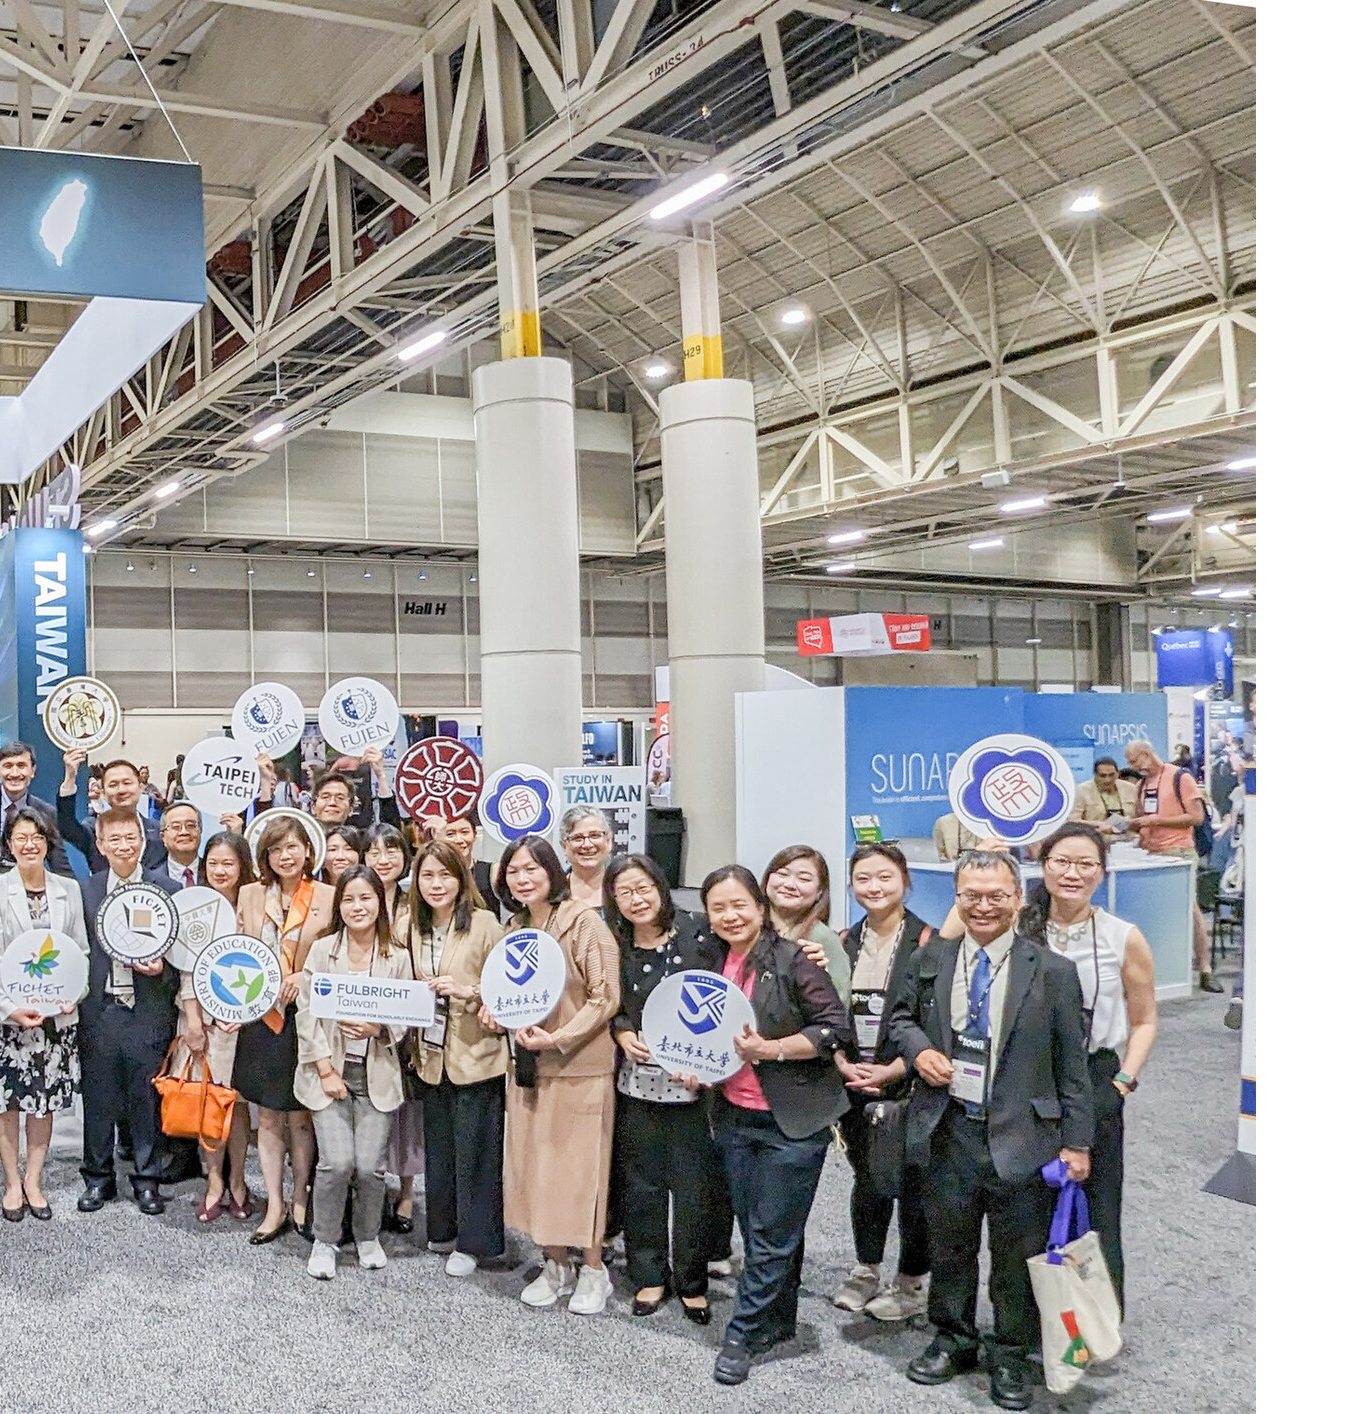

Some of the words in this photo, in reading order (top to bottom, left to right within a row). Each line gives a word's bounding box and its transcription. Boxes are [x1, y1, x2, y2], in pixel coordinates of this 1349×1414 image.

[404, 602, 432, 615] Hall
[435, 602, 447, 615] H
[255, 719, 299, 752] FUJEN
[340, 722, 390, 748] FUJEN
[1083, 723, 1149, 746] SUNAPSIS
[203, 763, 256, 784] TAIPEI
[562, 776, 599, 785] STUDY
[601, 775, 612, 784] IN
[871, 752, 959, 793] SUNAP
[219, 783, 254, 800] TECH
[562, 785, 642, 805] TAIWAN
[132, 895, 167, 929] FICHET
[210, 938, 274, 970] EDUCATION
[201, 959, 211, 976] OF
[7, 982, 65, 995] FICHET
[337, 983, 410, 999] FULBRIGHT
[23, 995, 73, 1006] Taiwan
[199, 979, 243, 1019] MINISTRY
[336, 995, 379, 1009] Taiwan
[656, 1053, 692, 1069] UNIVERSITY
[705, 1065, 726, 1076] TAIPEI
